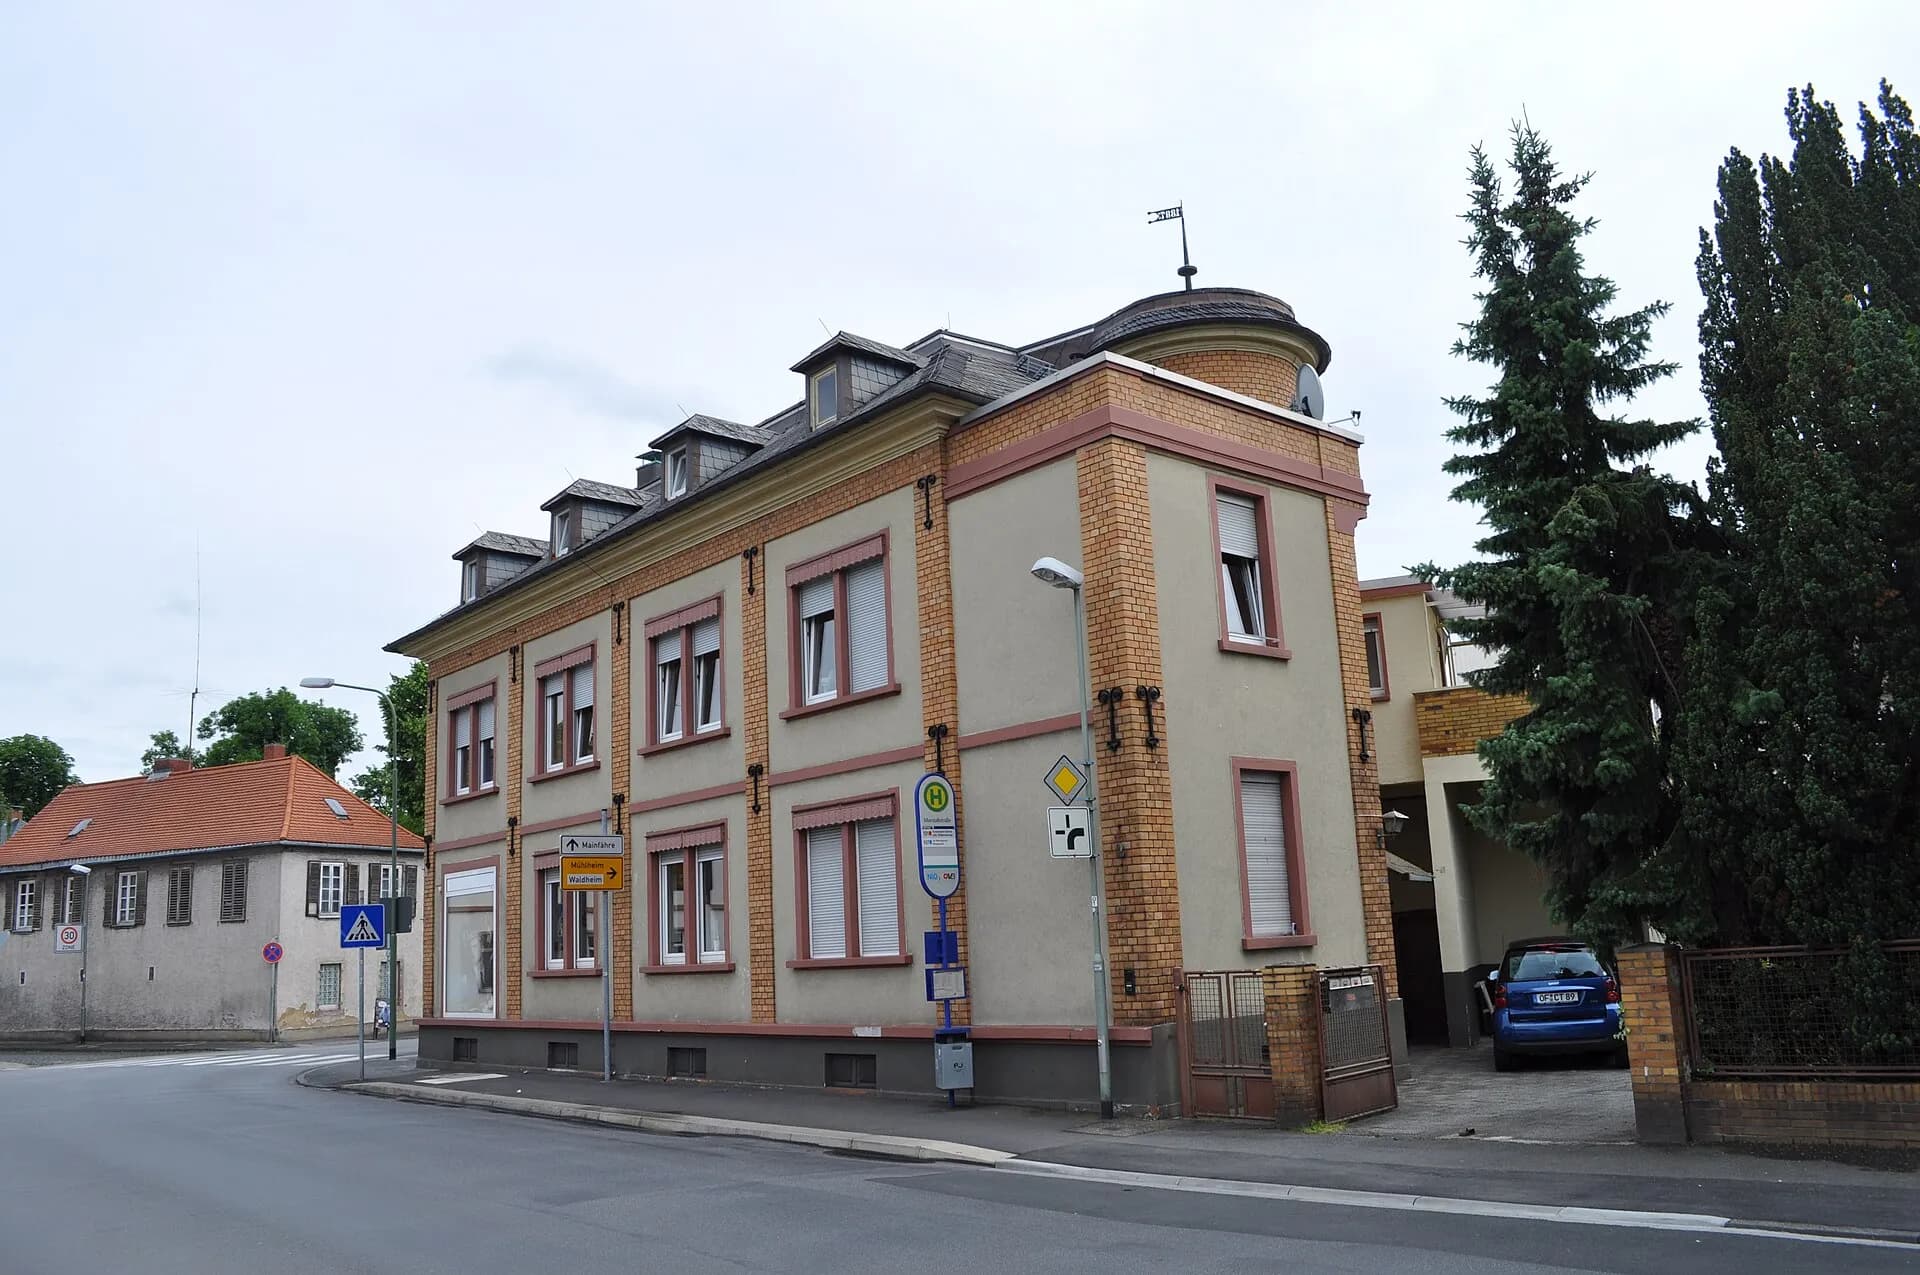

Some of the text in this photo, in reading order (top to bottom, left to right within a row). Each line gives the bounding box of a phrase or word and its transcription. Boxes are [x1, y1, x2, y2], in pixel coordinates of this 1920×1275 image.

[930, 788, 942, 805] H
[581, 841, 616, 849] Mainfähre
[571, 861, 604, 869] Mühlheim
[568, 875, 603, 883] Waldheim
[64, 931, 75, 940] 30
